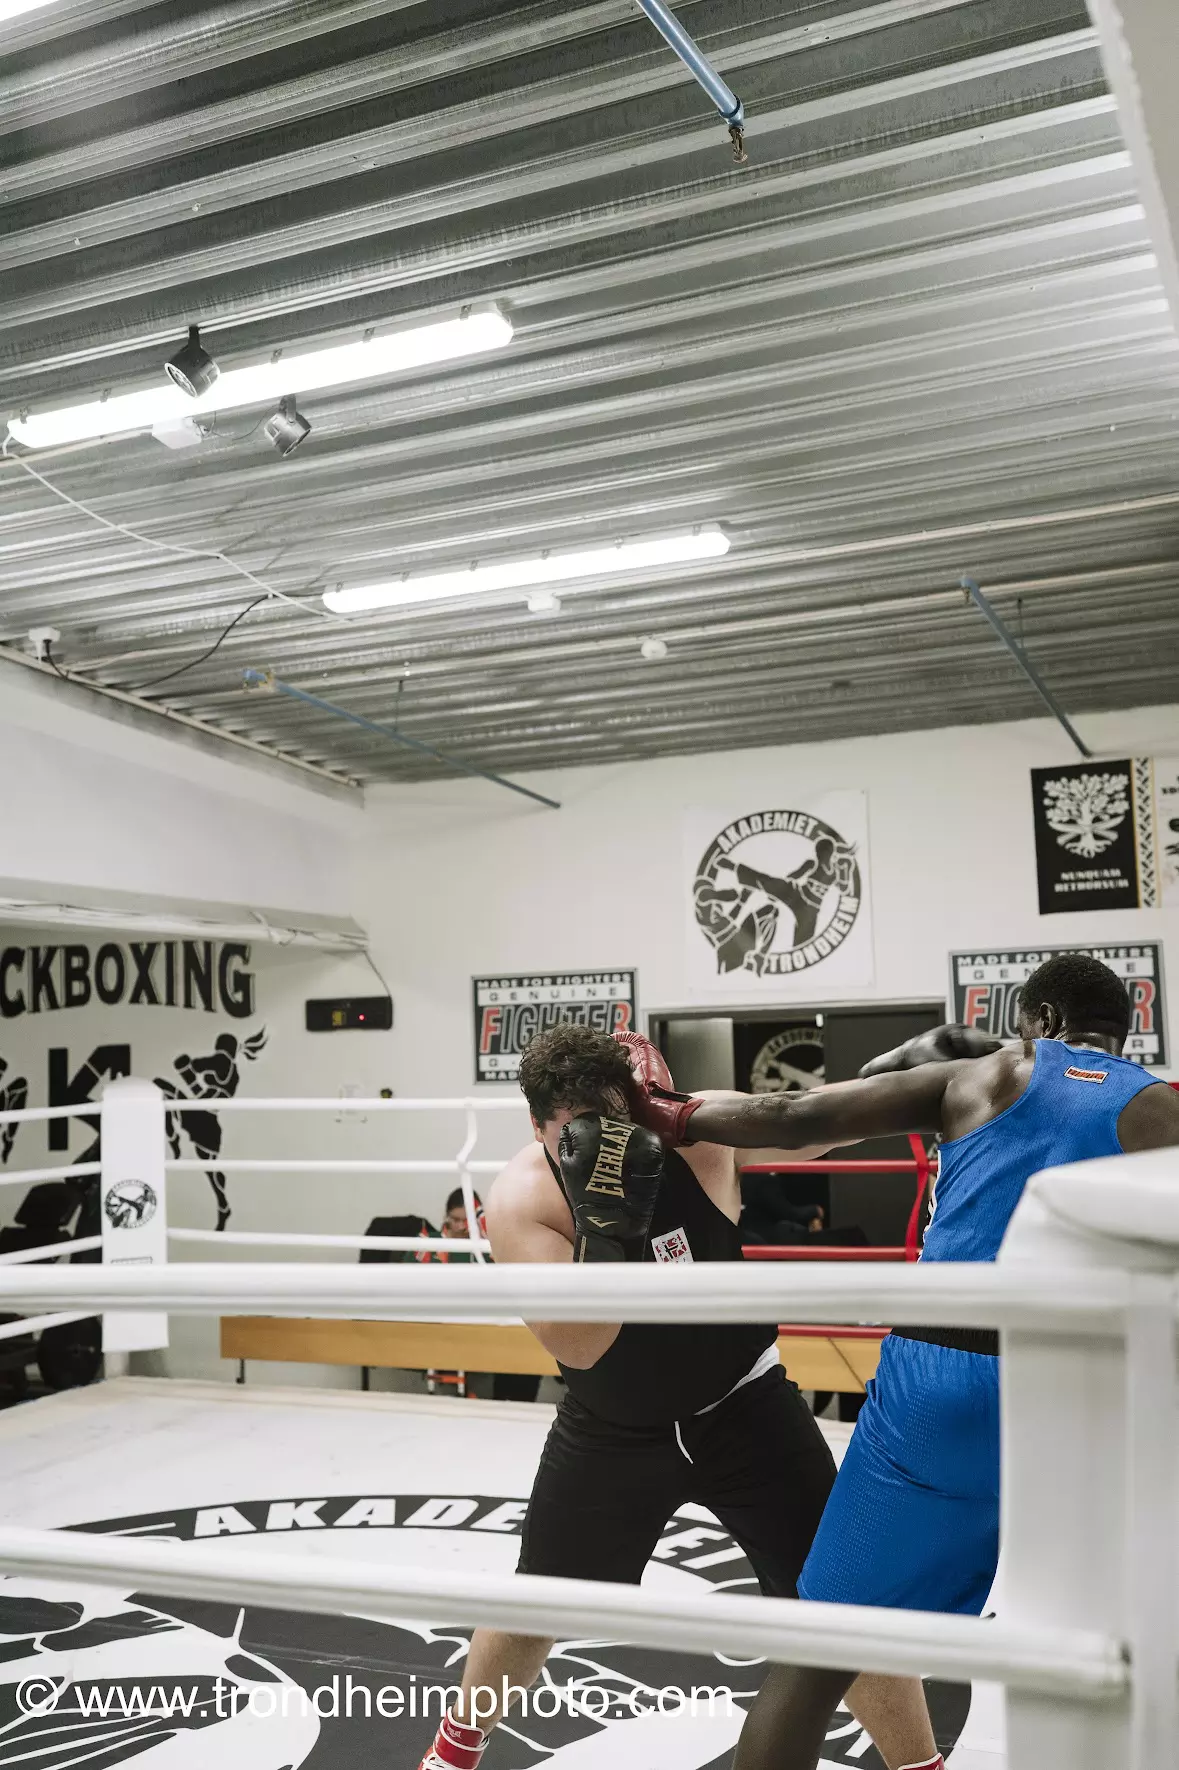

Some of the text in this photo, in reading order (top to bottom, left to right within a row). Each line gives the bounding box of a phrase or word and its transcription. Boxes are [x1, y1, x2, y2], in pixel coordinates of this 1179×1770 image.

[717, 812, 820, 853] AKADEMIET
[768, 896, 859, 973] TRONDHEIM
[957, 955, 1009, 967] MADE
[477, 973, 631, 989] MADE FOR FIGHTERS
[489, 986, 617, 1002] GENUINE
[484, 1071, 520, 1080] MAD
[585, 1116, 638, 1199] EVERLAST
